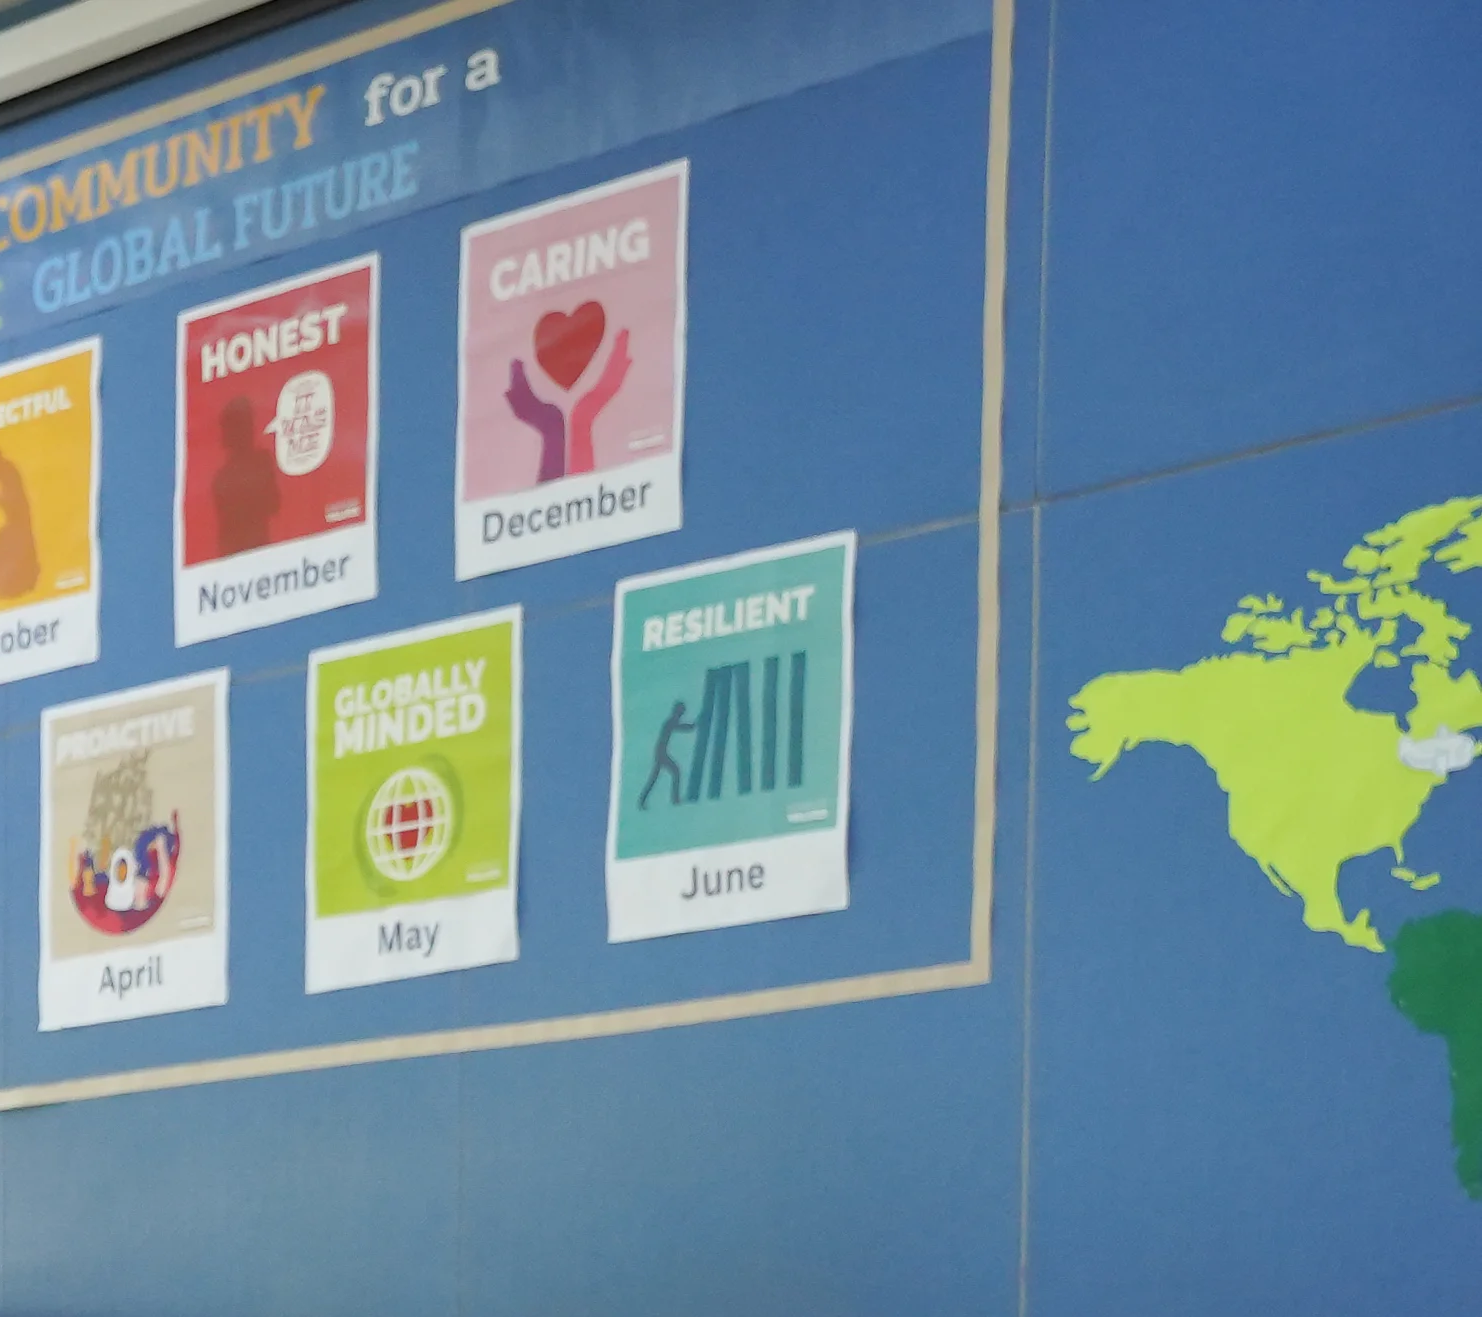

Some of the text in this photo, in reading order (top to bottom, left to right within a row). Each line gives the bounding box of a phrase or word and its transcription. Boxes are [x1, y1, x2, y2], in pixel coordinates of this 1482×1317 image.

[363, 65, 446, 126] for
[464, 48, 500, 88] a
[32, 217, 222, 312] GLOBAL
[233, 143, 420, 251] FUTURE
[489, 218, 651, 301] CARING
[201, 303, 348, 383] HONEST
[482, 480, 652, 545] December
[199, 552, 351, 616] November
[642, 585, 816, 652] RESILIENT
[333, 659, 486, 719] GLOBALLY
[56, 706, 195, 766] PROACTIVE
[333, 693, 486, 759] MINDED
[680, 862, 766, 901] June
[378, 923, 439, 957] May
[98, 956, 164, 1000] April
